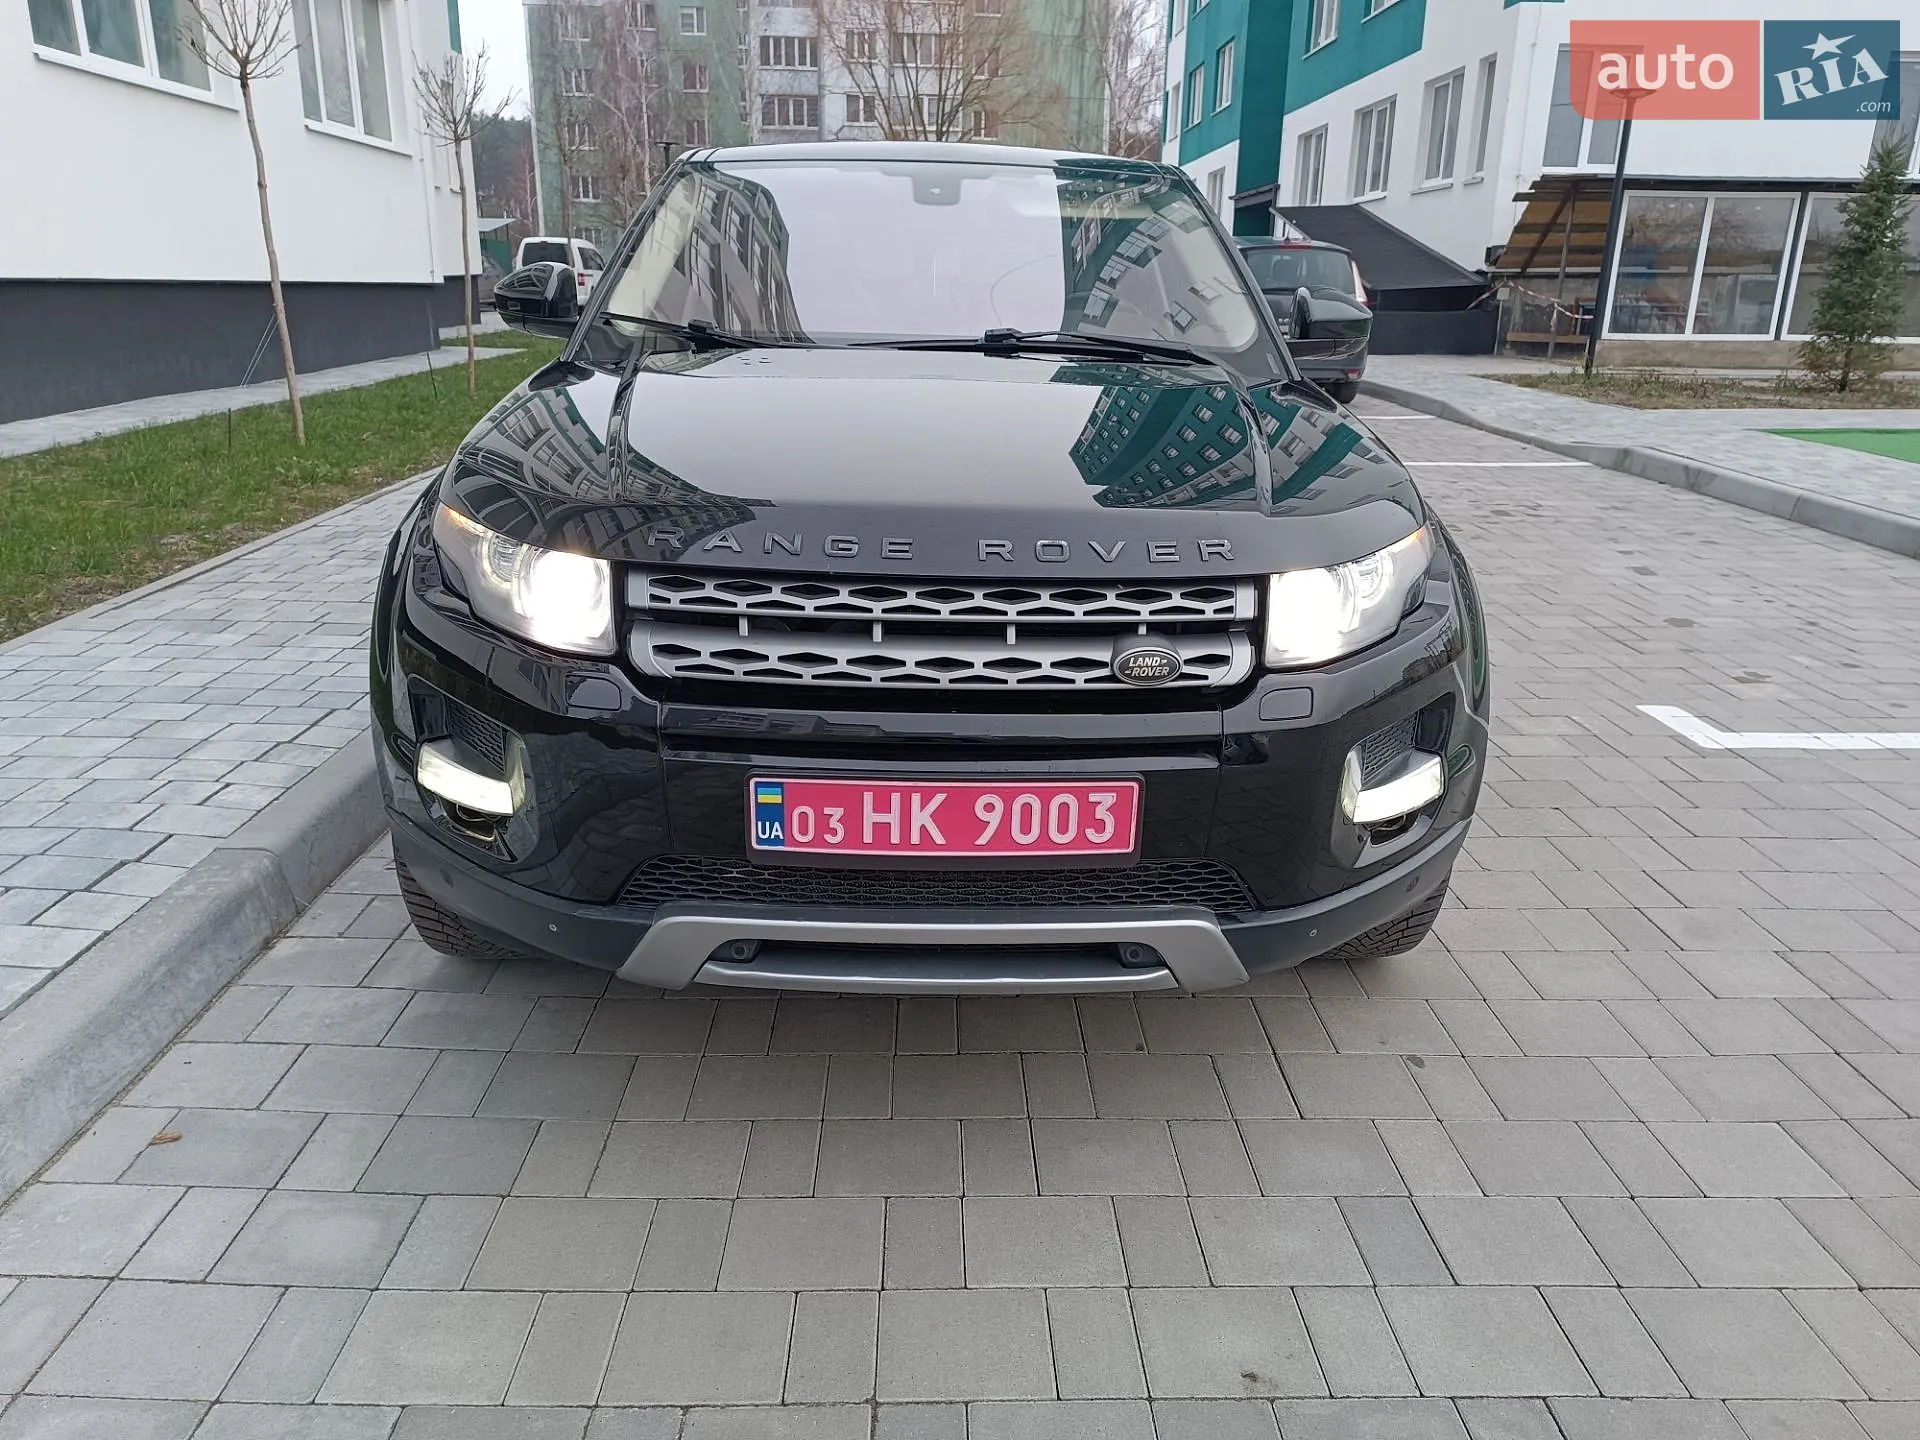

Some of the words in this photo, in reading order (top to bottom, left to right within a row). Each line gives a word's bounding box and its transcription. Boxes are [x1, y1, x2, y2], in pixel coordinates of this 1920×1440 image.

[647, 526, 914, 559] RANGE
[978, 538, 1234, 562] ROVER
[1129, 657, 1161, 667] LAND
[1131, 666, 1170, 677] ROVER
[757, 821, 784, 840] UA
[791, 805, 845, 844] 03
[862, 791, 948, 845] HK
[974, 792, 1117, 845] 9003
